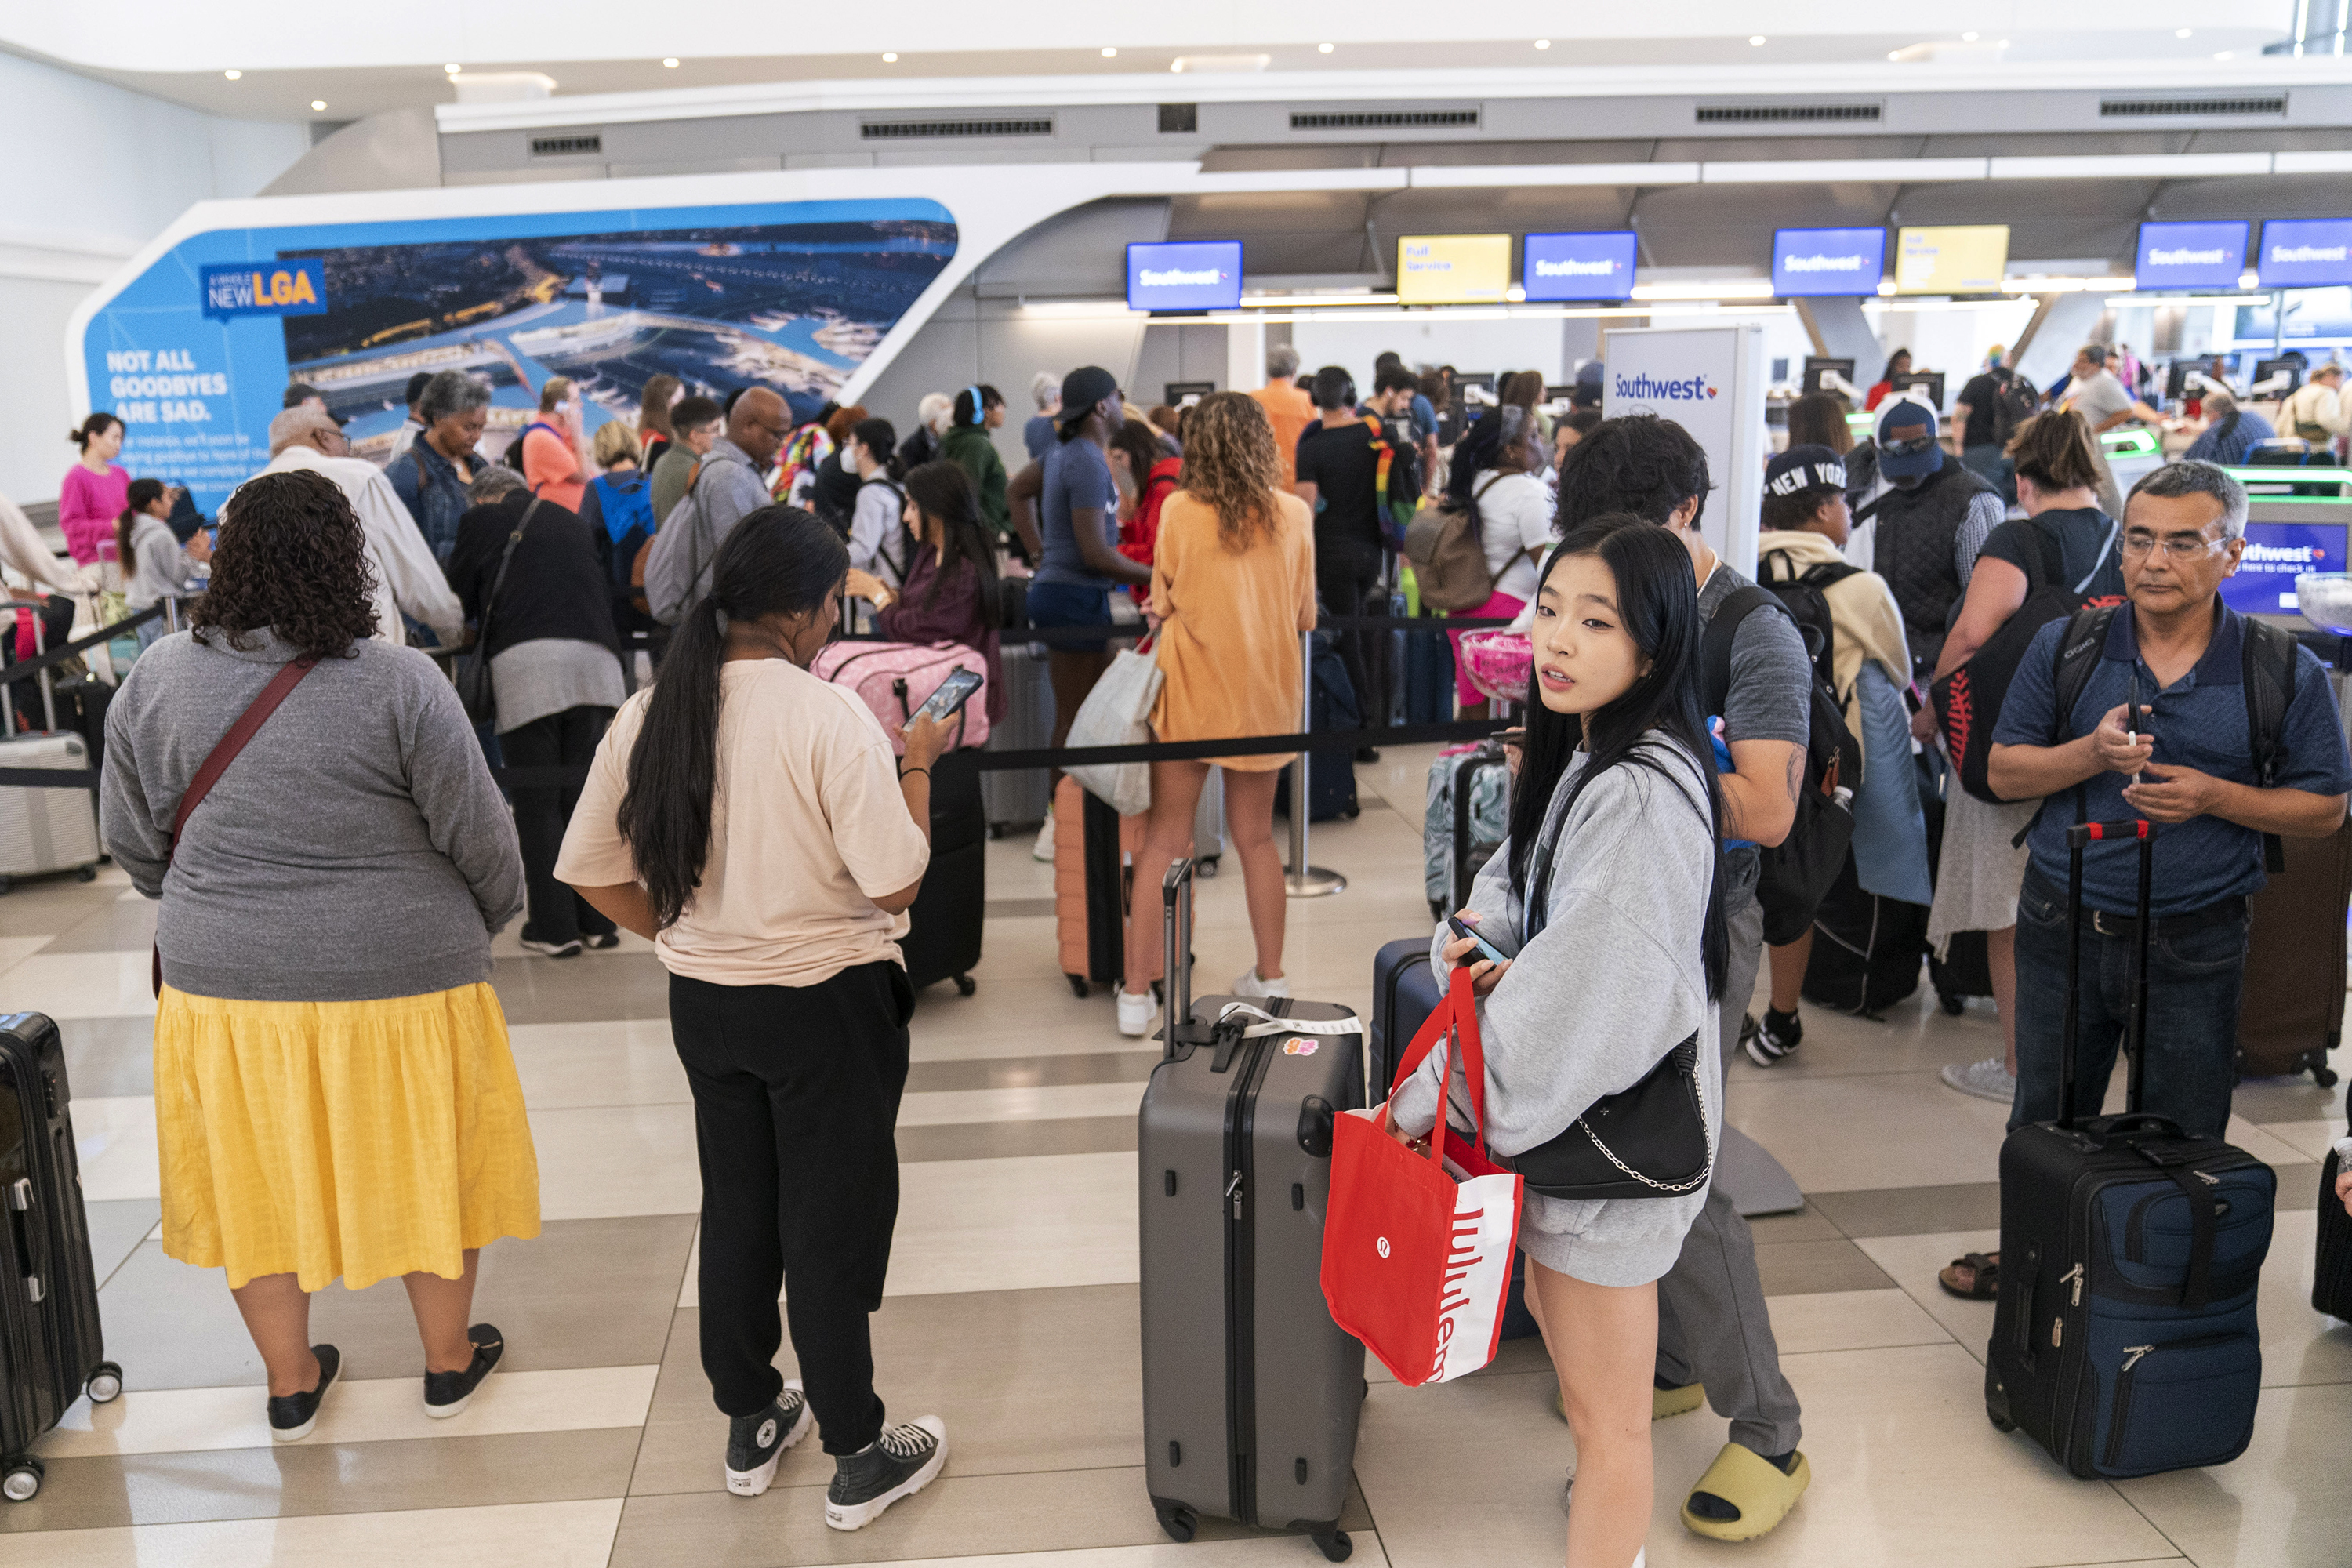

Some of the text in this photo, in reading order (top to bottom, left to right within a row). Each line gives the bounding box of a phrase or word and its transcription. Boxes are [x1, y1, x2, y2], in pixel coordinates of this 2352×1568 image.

[1535, 258, 1613, 276] Southwest
[209, 269, 317, 309] NEW LGA
[106, 348, 196, 373] NOT ALL
[110, 372, 228, 398] GOODBYES
[1615, 372, 1705, 401] Southwest
[116, 399, 212, 423] ARE SAD.
[1770, 465, 1809, 497] NEW
[2064, 637, 2096, 659] OGIO
